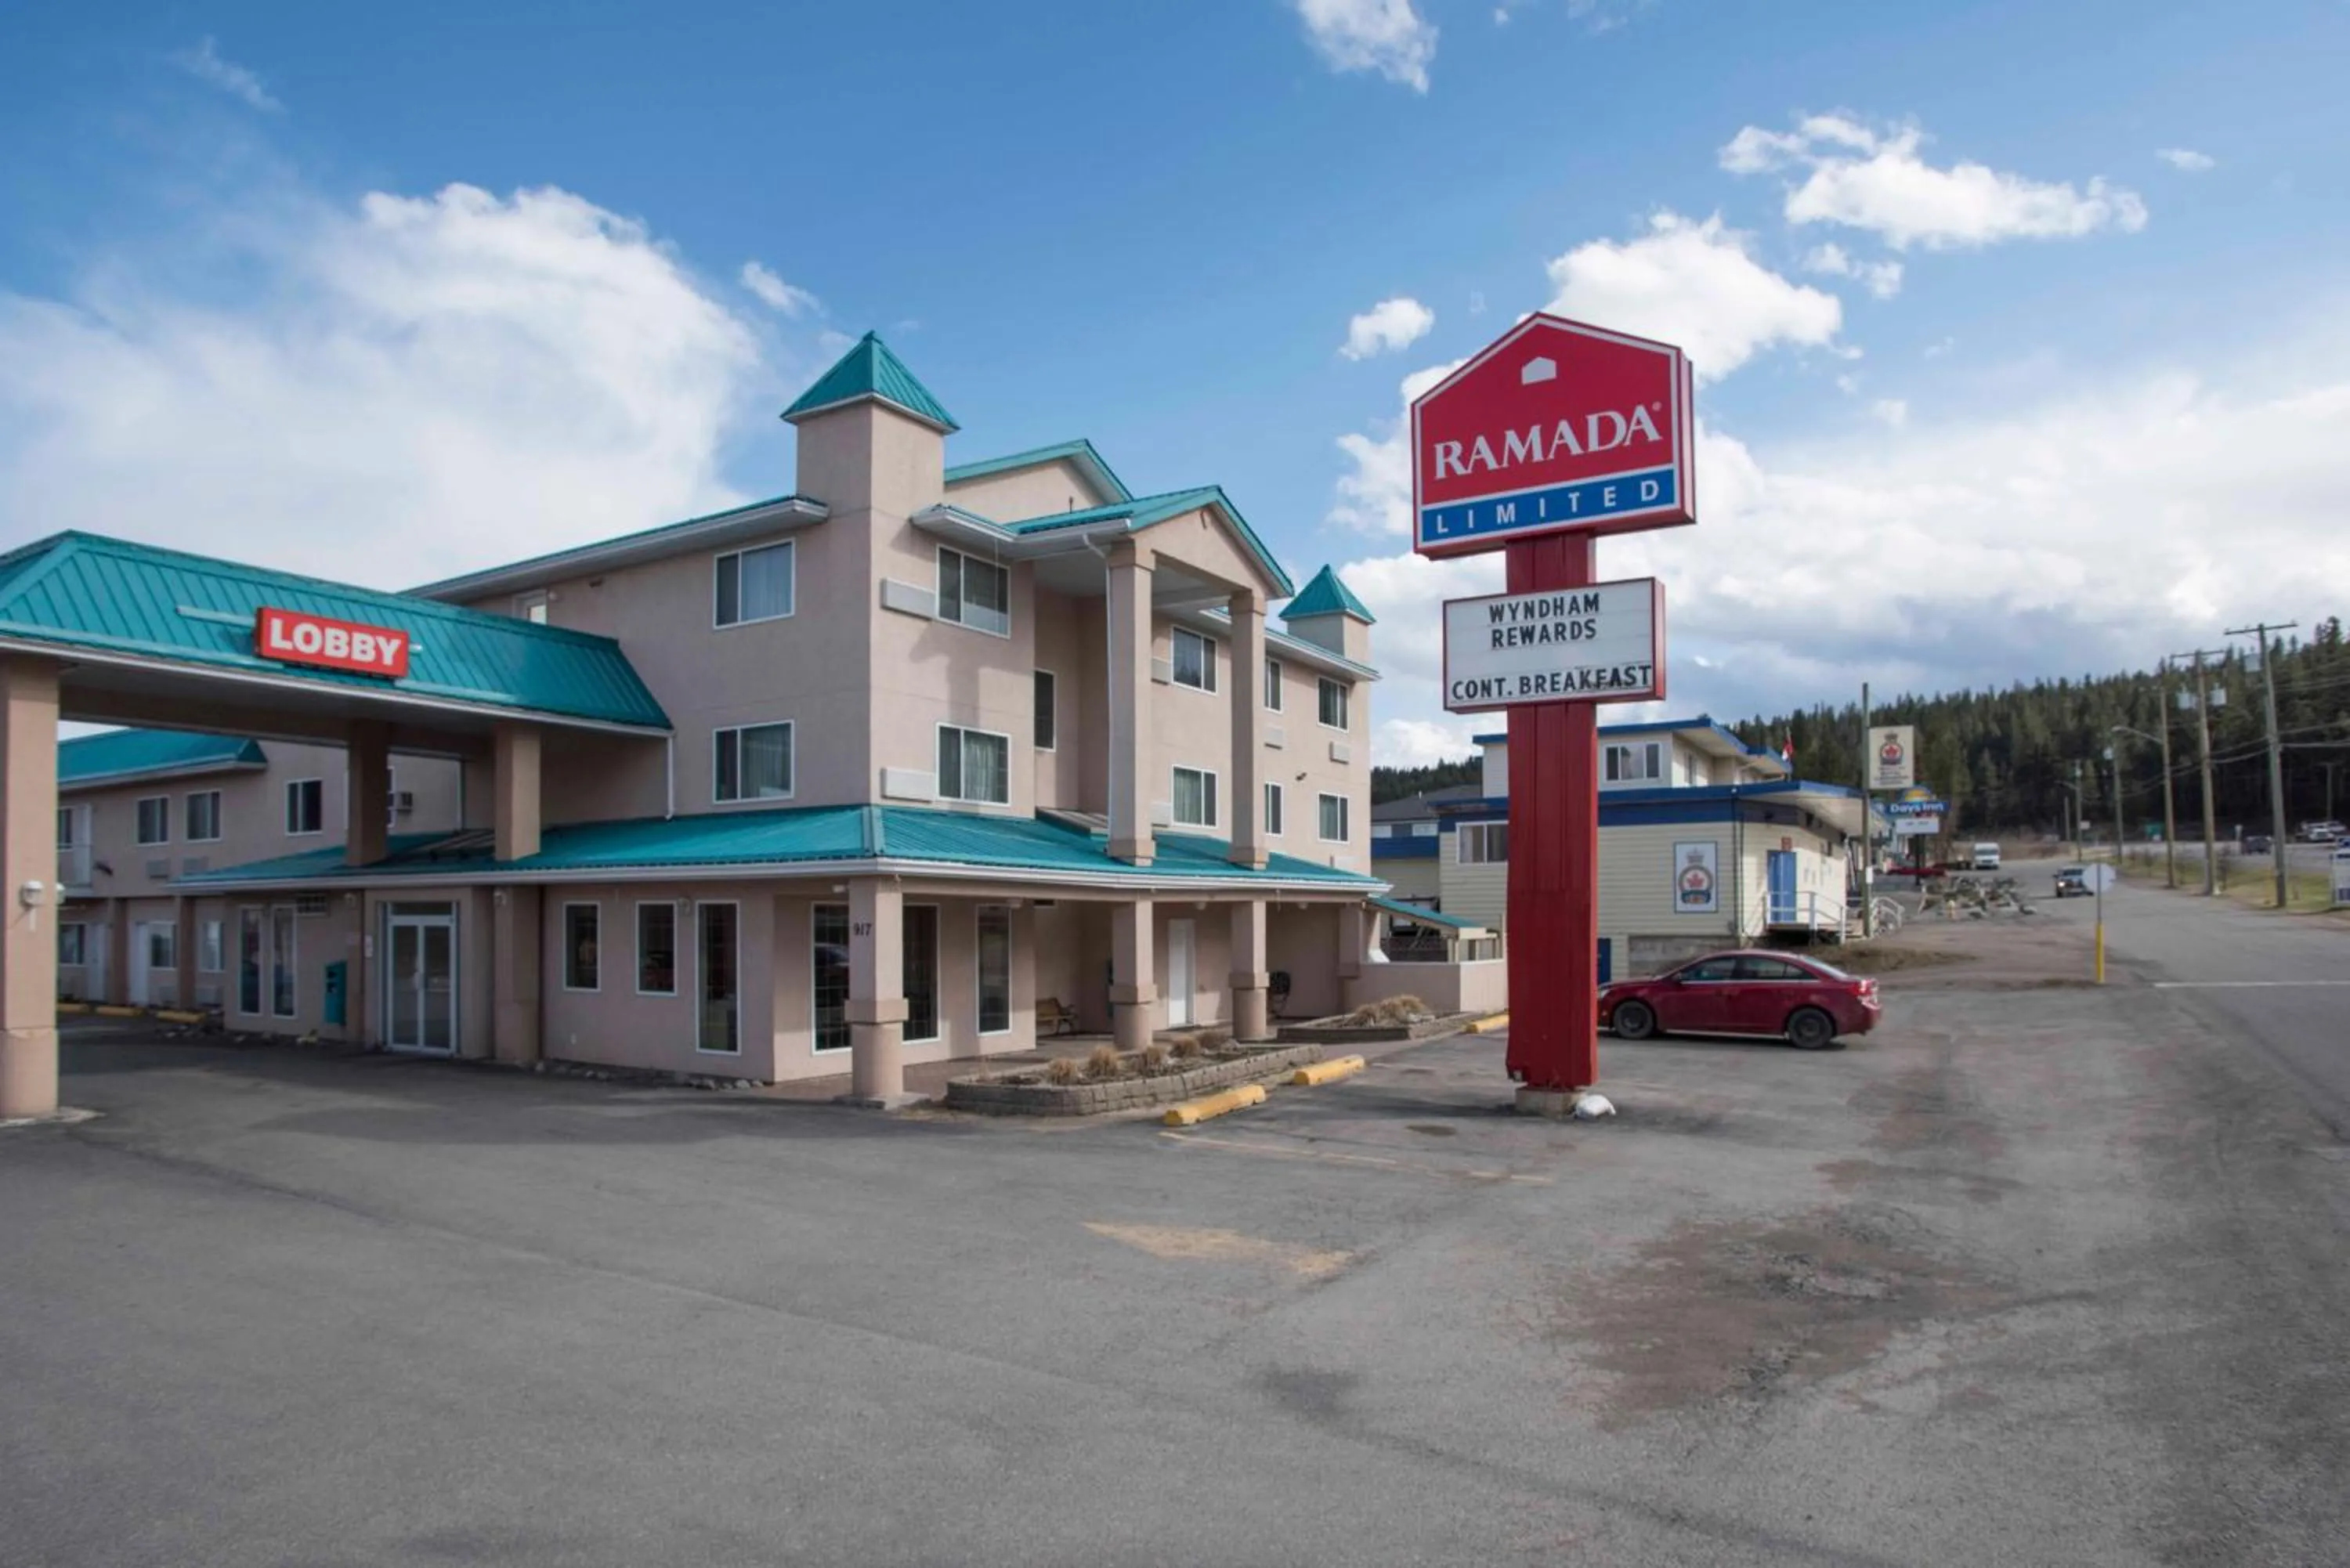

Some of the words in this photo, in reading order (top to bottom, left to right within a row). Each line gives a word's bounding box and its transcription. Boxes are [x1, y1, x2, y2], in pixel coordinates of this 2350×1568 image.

[1434, 405, 1662, 479] RAMADA
[1437, 481, 1660, 533] LIMITED
[1489, 592, 1600, 623] WYNDHAM
[270, 618, 401, 666] LOBBY
[1491, 619, 1596, 649] REWARDS
[1452, 677, 1513, 699] CONT.
[1519, 666, 1652, 694] BREAKFAST
[1889, 804, 1922, 813] Days
[854, 922, 872, 936] 917
